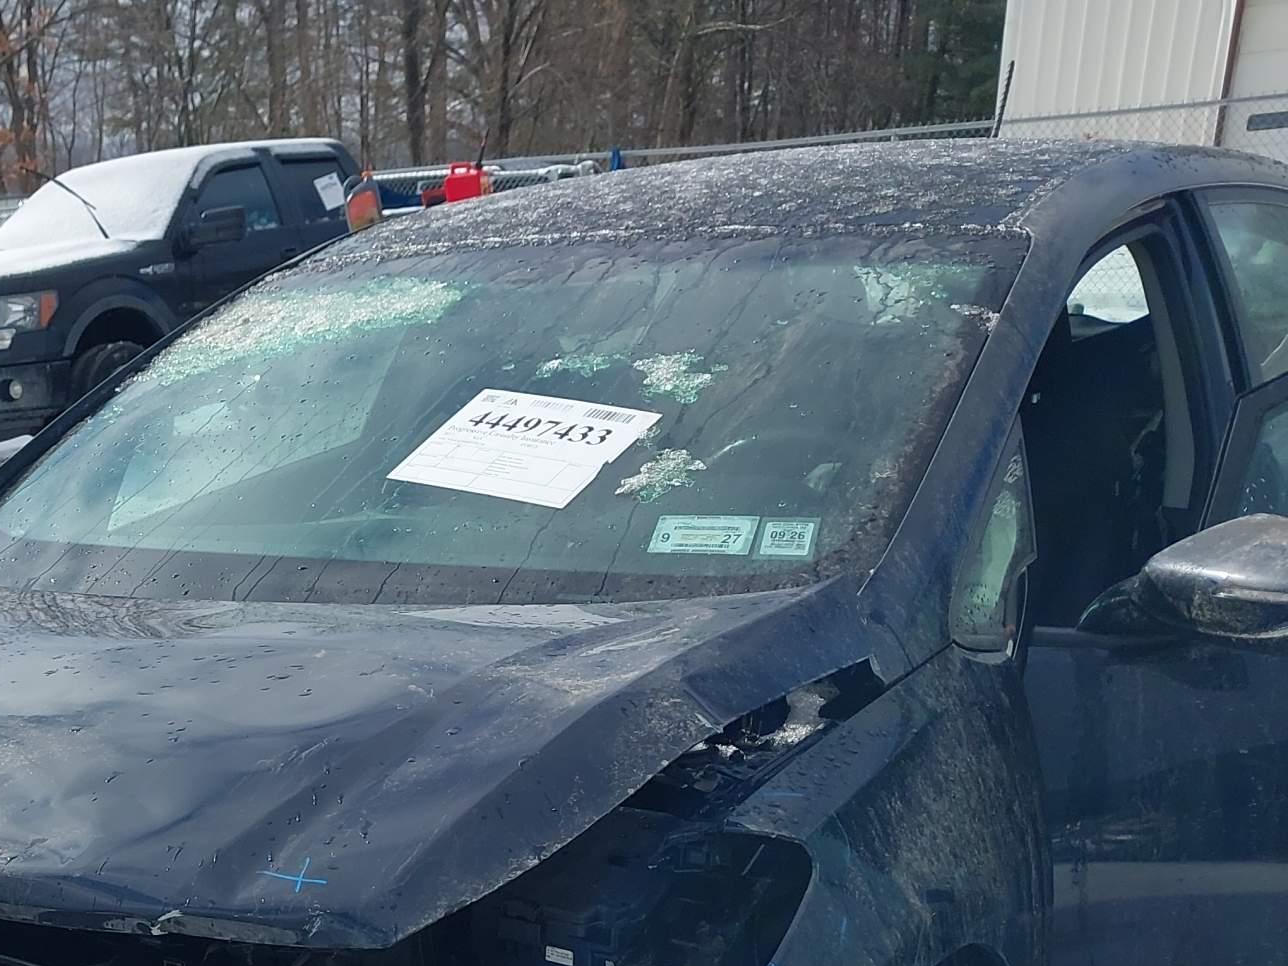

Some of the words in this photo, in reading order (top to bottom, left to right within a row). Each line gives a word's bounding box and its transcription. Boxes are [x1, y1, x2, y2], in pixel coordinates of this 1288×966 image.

[469, 411, 613, 446] 44497433
[660, 532, 671, 543] 9
[721, 533, 742, 544] 27
[770, 530, 786, 540] 09
[789, 531, 805, 541] 26
